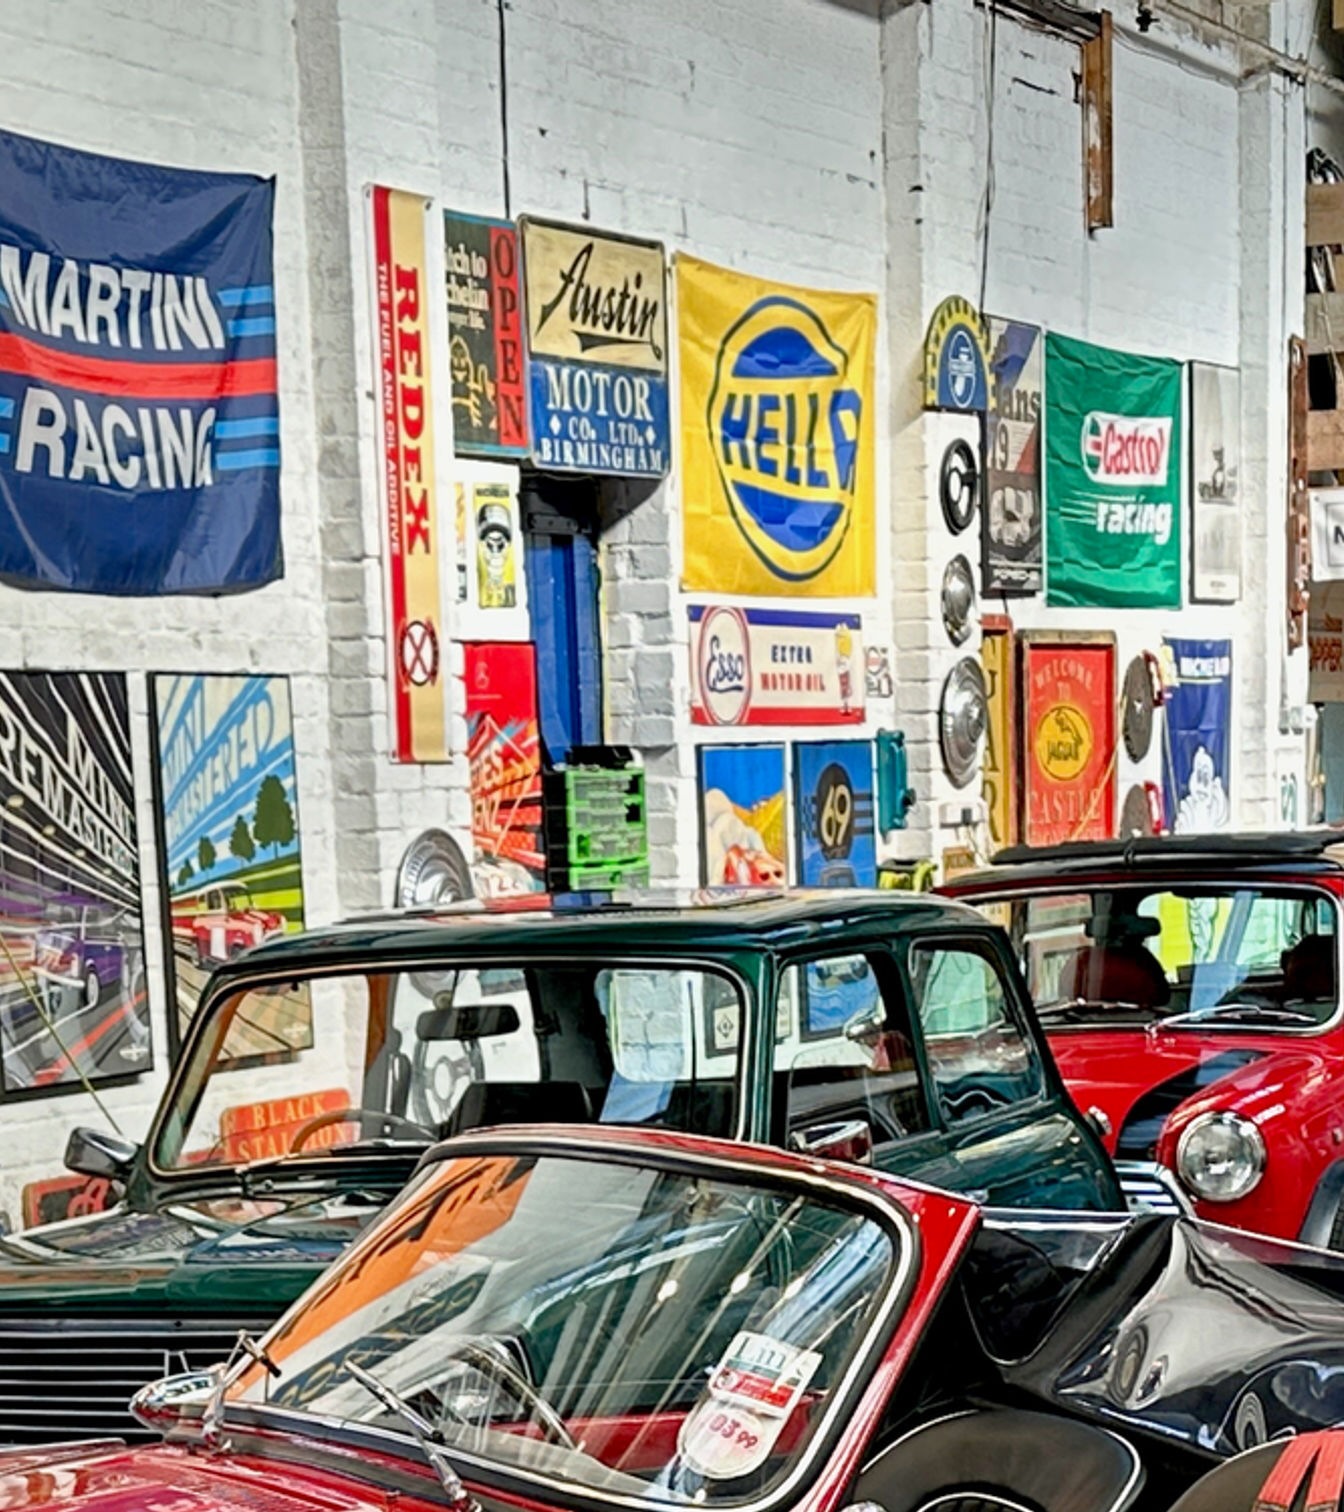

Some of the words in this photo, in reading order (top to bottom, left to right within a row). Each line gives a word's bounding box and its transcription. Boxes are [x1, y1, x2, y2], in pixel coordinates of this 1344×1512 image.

[0, 243, 225, 349] MARTINI
[535, 242, 662, 350] Austin
[381, 309, 392, 363] FUEL
[494, 233, 524, 440] OPEN
[383, 373, 393, 415] AND
[395, 264, 431, 556] REDEX
[545, 366, 655, 422] MOTOR
[15, 387, 216, 489] RACING
[540, 438, 663, 472] BIRMINGHAM
[1096, 493, 1173, 546] racing
[706, 635, 744, 693] Esso
[760, 671, 803, 692] MOTOR
[806, 673, 827, 692] OIL
[1034, 658, 1094, 690] WELCOME
[252, 1095, 327, 1130] BLACK
